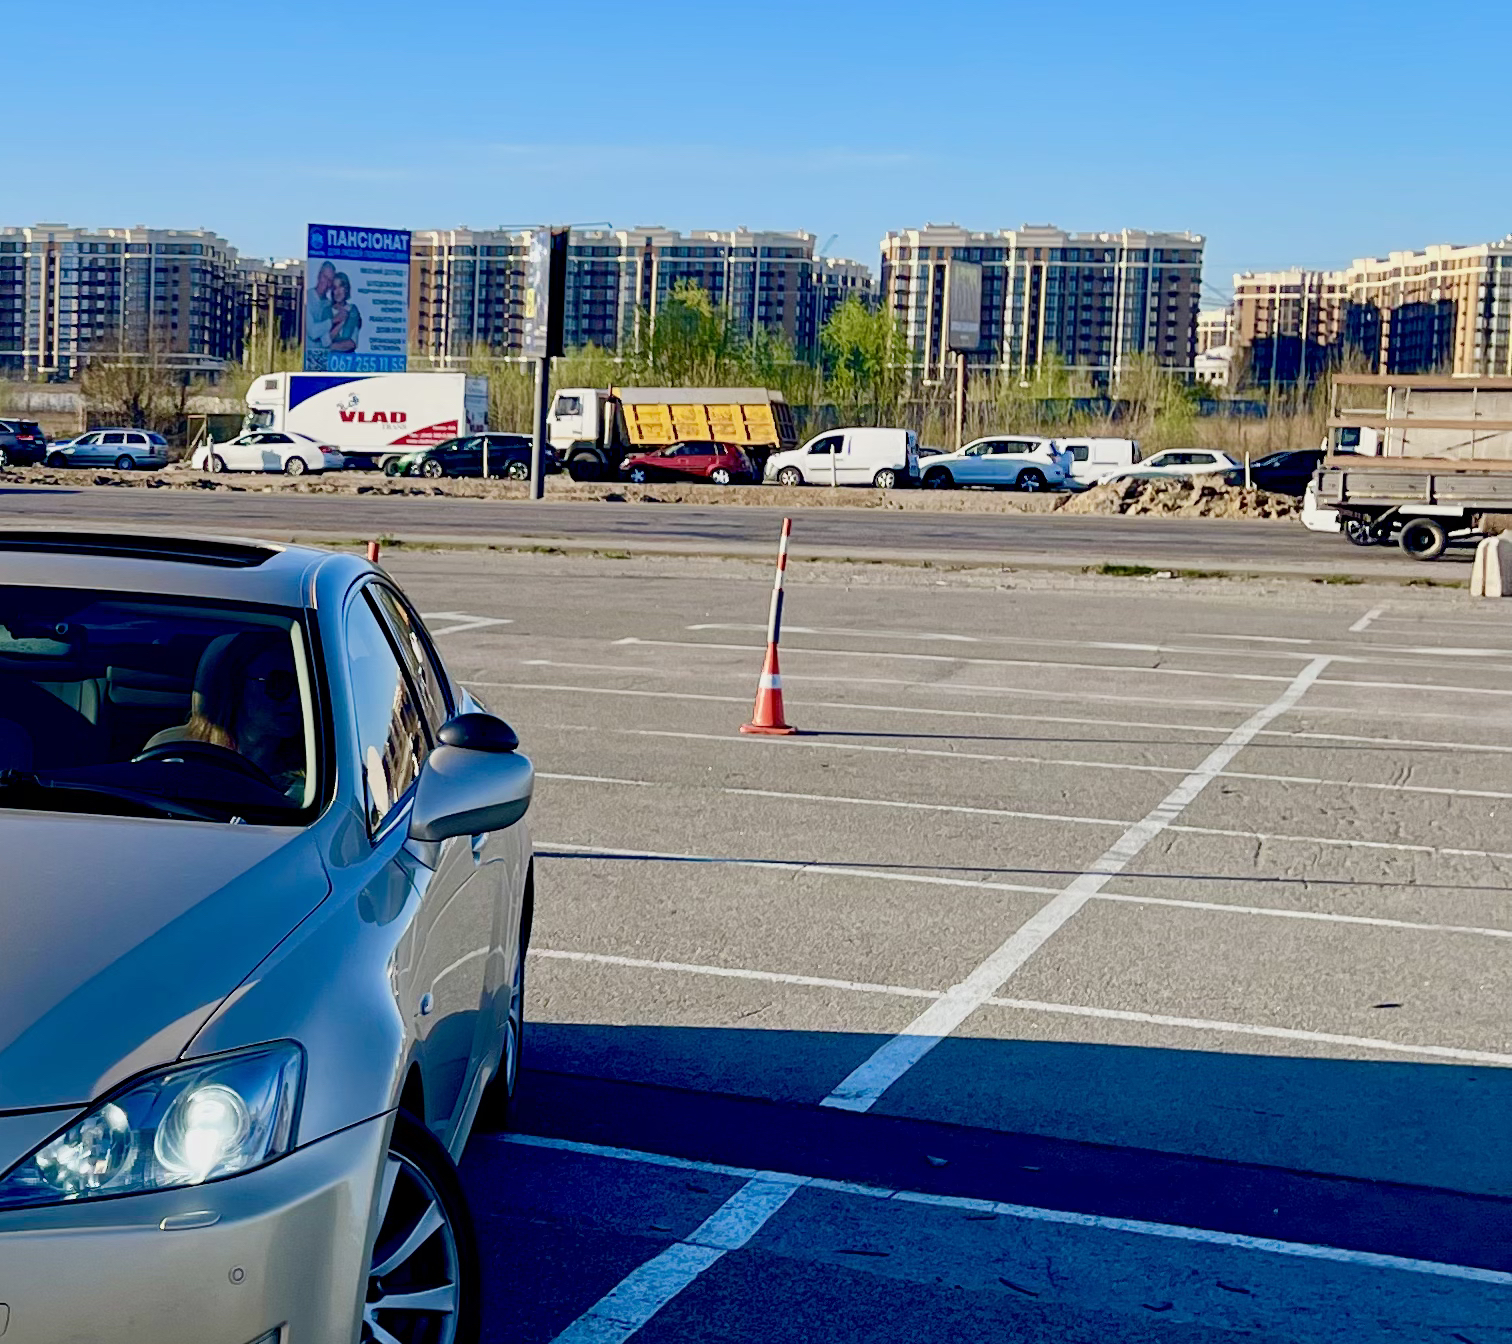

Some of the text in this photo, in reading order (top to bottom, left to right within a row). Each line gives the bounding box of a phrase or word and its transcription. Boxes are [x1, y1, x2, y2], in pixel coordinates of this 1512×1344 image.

[328, 229, 409, 251] ПАНСІОНАТ
[330, 355, 352, 371] 067
[355, 356, 376, 372] 255
[379, 357, 389, 371] 11
[339, 411, 407, 423] VLAD
